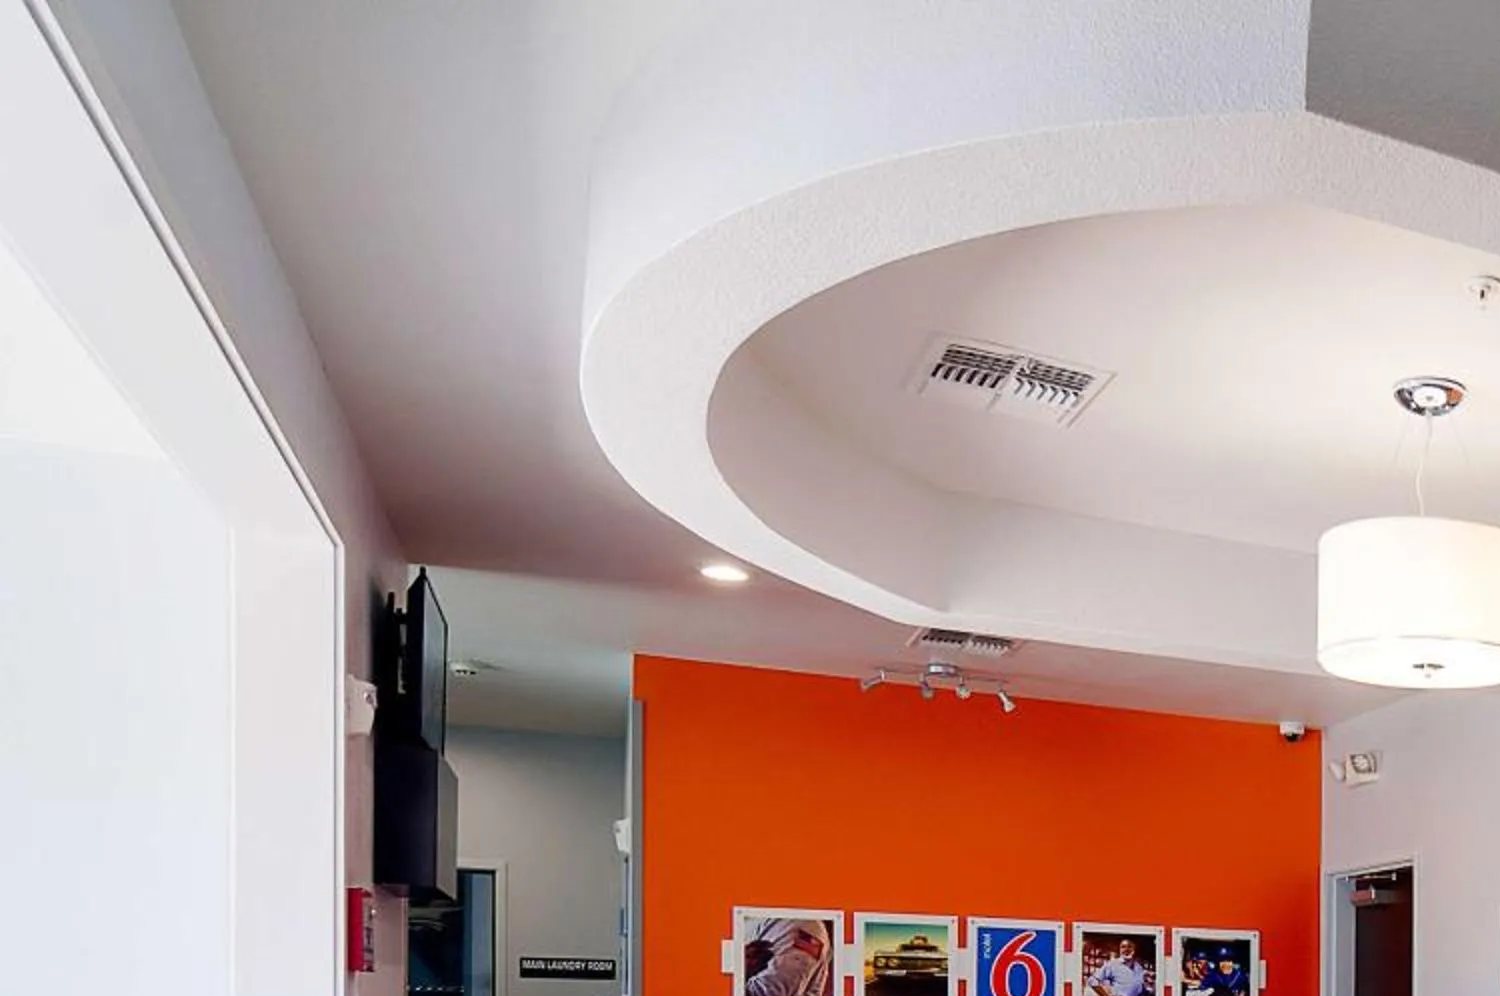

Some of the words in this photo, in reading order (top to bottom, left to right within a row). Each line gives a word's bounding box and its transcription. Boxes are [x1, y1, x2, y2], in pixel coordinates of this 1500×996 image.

[522, 959, 545, 969] MAIN
[547, 960, 586, 970] LAUNDRY
[587, 961, 613, 971] ROOM
